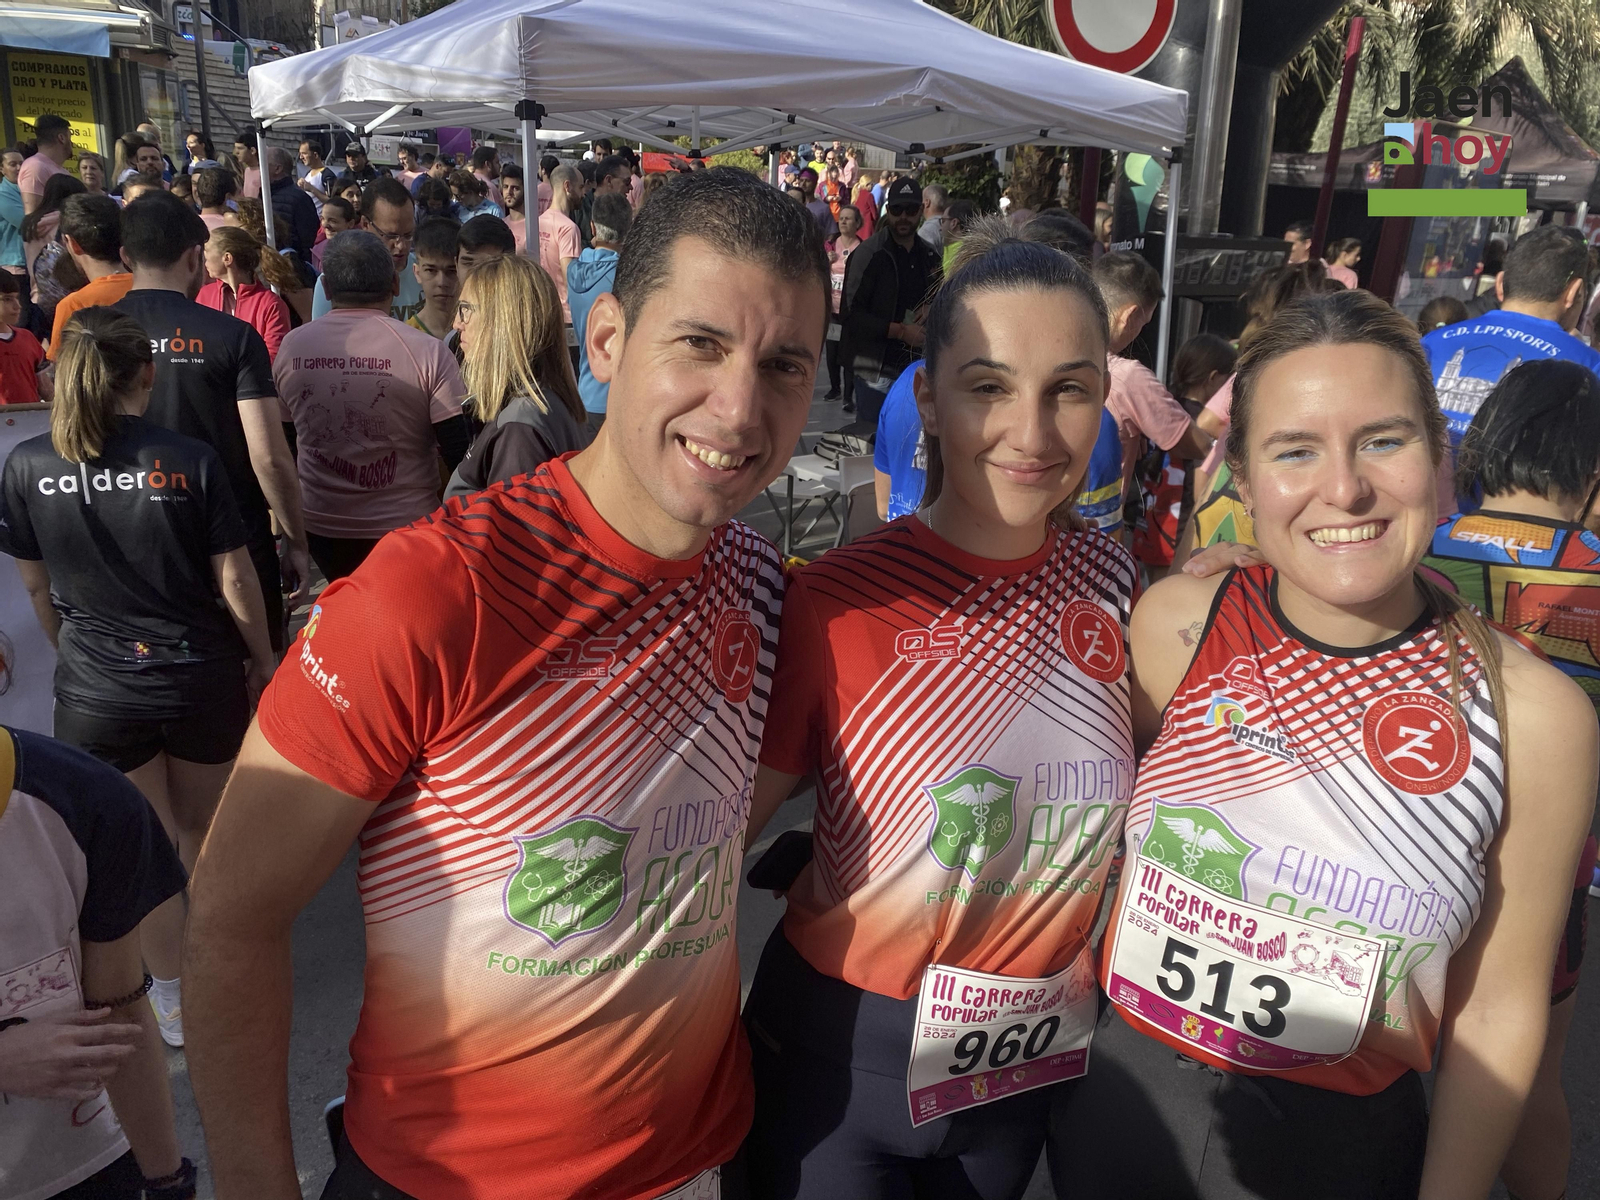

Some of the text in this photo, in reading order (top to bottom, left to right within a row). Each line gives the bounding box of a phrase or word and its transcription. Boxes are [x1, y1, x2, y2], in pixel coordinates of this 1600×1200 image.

[11, 61, 86, 76] COMPRAMOS
[12, 76, 88, 91] ORO Y PLATA
[28, 96, 55, 105] mejor
[57, 97, 86, 108] precio
[26, 106, 83, 118] del Mercado
[83, 128, 92, 137] al
[1442, 325, 1561, 358] C.D. LPP SPORTS
[358, 450, 397, 489] BOSCO
[1075, 603, 1108, 620] ZANCADA
[909, 648, 957, 660] OFFSIDE
[550, 667, 607, 678] OFFSIDE
[1383, 695, 1456, 723] LA ZANCADA
[1273, 844, 1455, 940] FUNDACIÓN
[1127, 915, 1158, 937] 2024
[1144, 917, 1160, 930] ENERO
[1231, 936, 1255, 958] JUAN
[1257, 931, 1288, 962] BOSCO
[487, 950, 628, 978] FORMACIÓN
[1156, 936, 1292, 1039] 513
[923, 1031, 957, 1039] 2024
[948, 1015, 1061, 1076] 960
